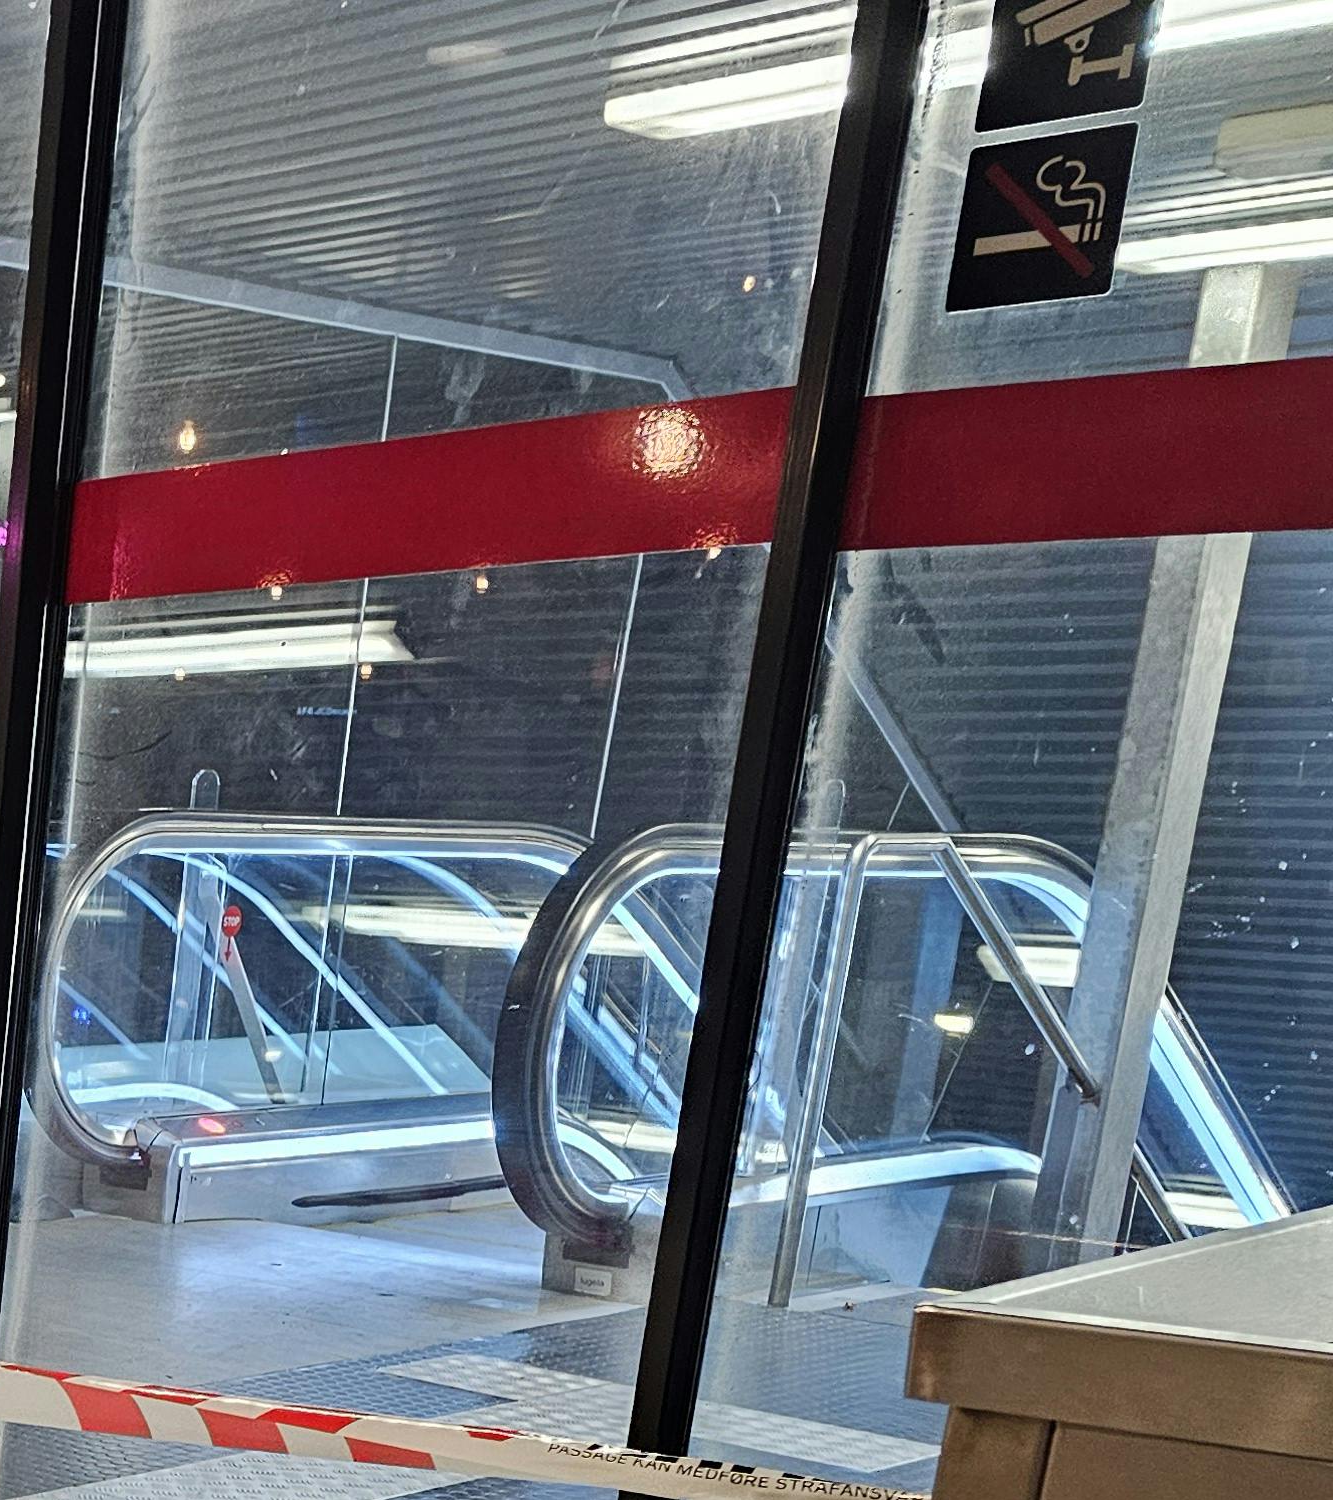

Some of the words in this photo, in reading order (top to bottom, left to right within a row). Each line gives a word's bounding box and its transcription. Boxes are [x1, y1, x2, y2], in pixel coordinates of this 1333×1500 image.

[223, 916, 240, 927] STOP
[547, 1441, 626, 1466] PASSAGE
[633, 1453, 672, 1474] KAN
[675, 1461, 769, 1490] MEDFØRE
